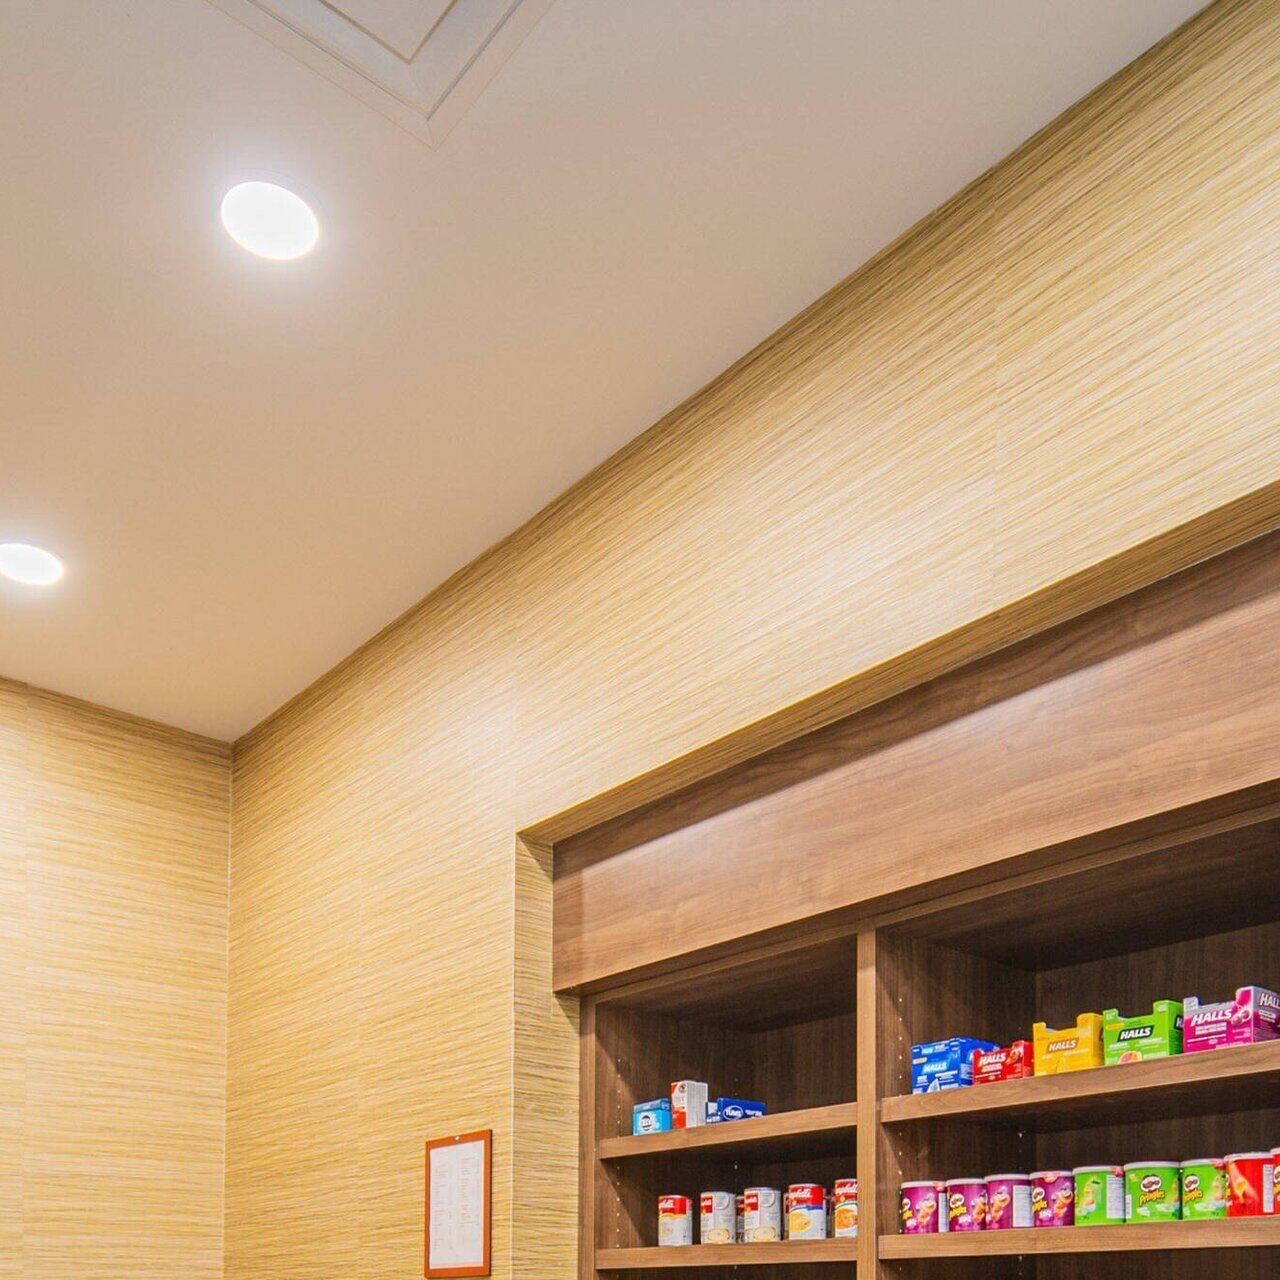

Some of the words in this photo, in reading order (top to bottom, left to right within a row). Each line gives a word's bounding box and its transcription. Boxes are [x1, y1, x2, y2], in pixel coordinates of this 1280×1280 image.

[1191, 1009, 1232, 1026] HALLS
[1121, 1027, 1151, 1040] HALLS
[1049, 1039, 1077, 1051] HALLS
[978, 1053, 1006, 1066] HALLS
